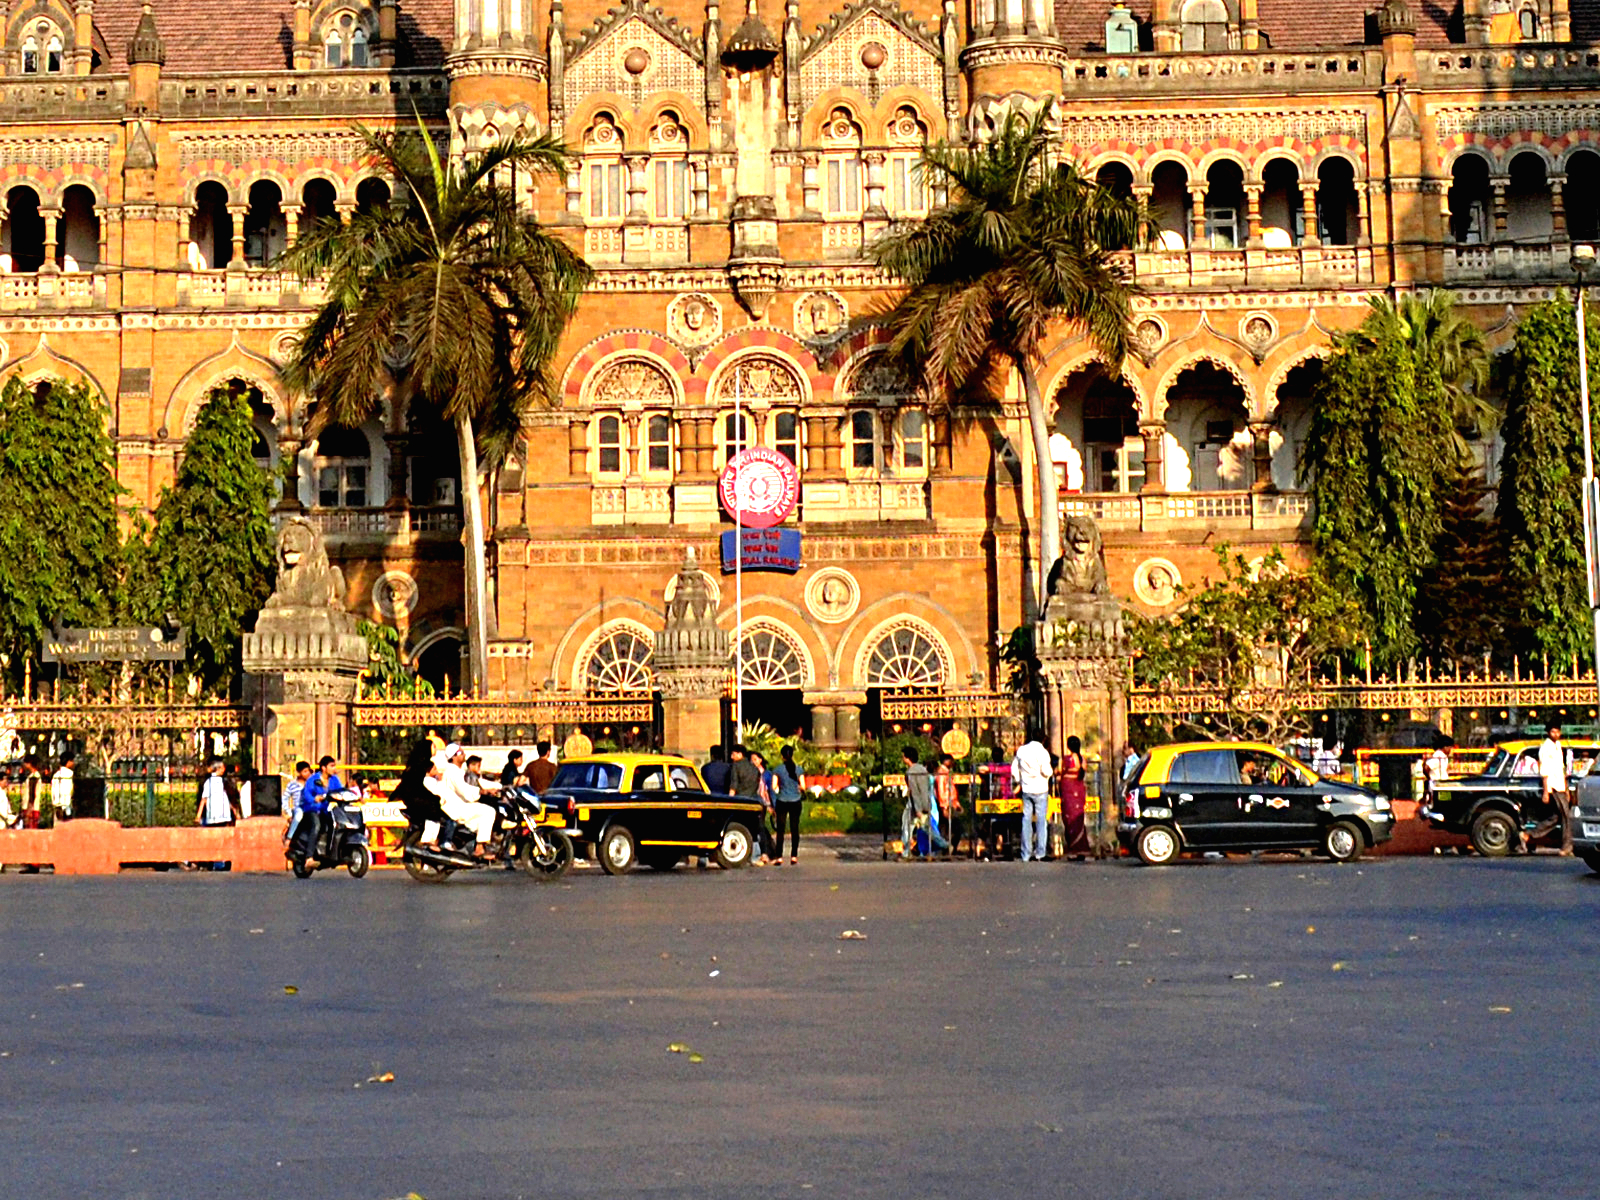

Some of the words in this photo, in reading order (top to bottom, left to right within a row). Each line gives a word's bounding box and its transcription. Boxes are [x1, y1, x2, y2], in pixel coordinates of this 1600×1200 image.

[749, 451, 784, 468] INDIAN
[774, 466, 795, 517] RAILWAYS
[89, 629, 138, 641] UNESCO
[48, 640, 90, 655] World
[156, 641, 181, 652] Site
[364, 807, 401, 817] POLIC
